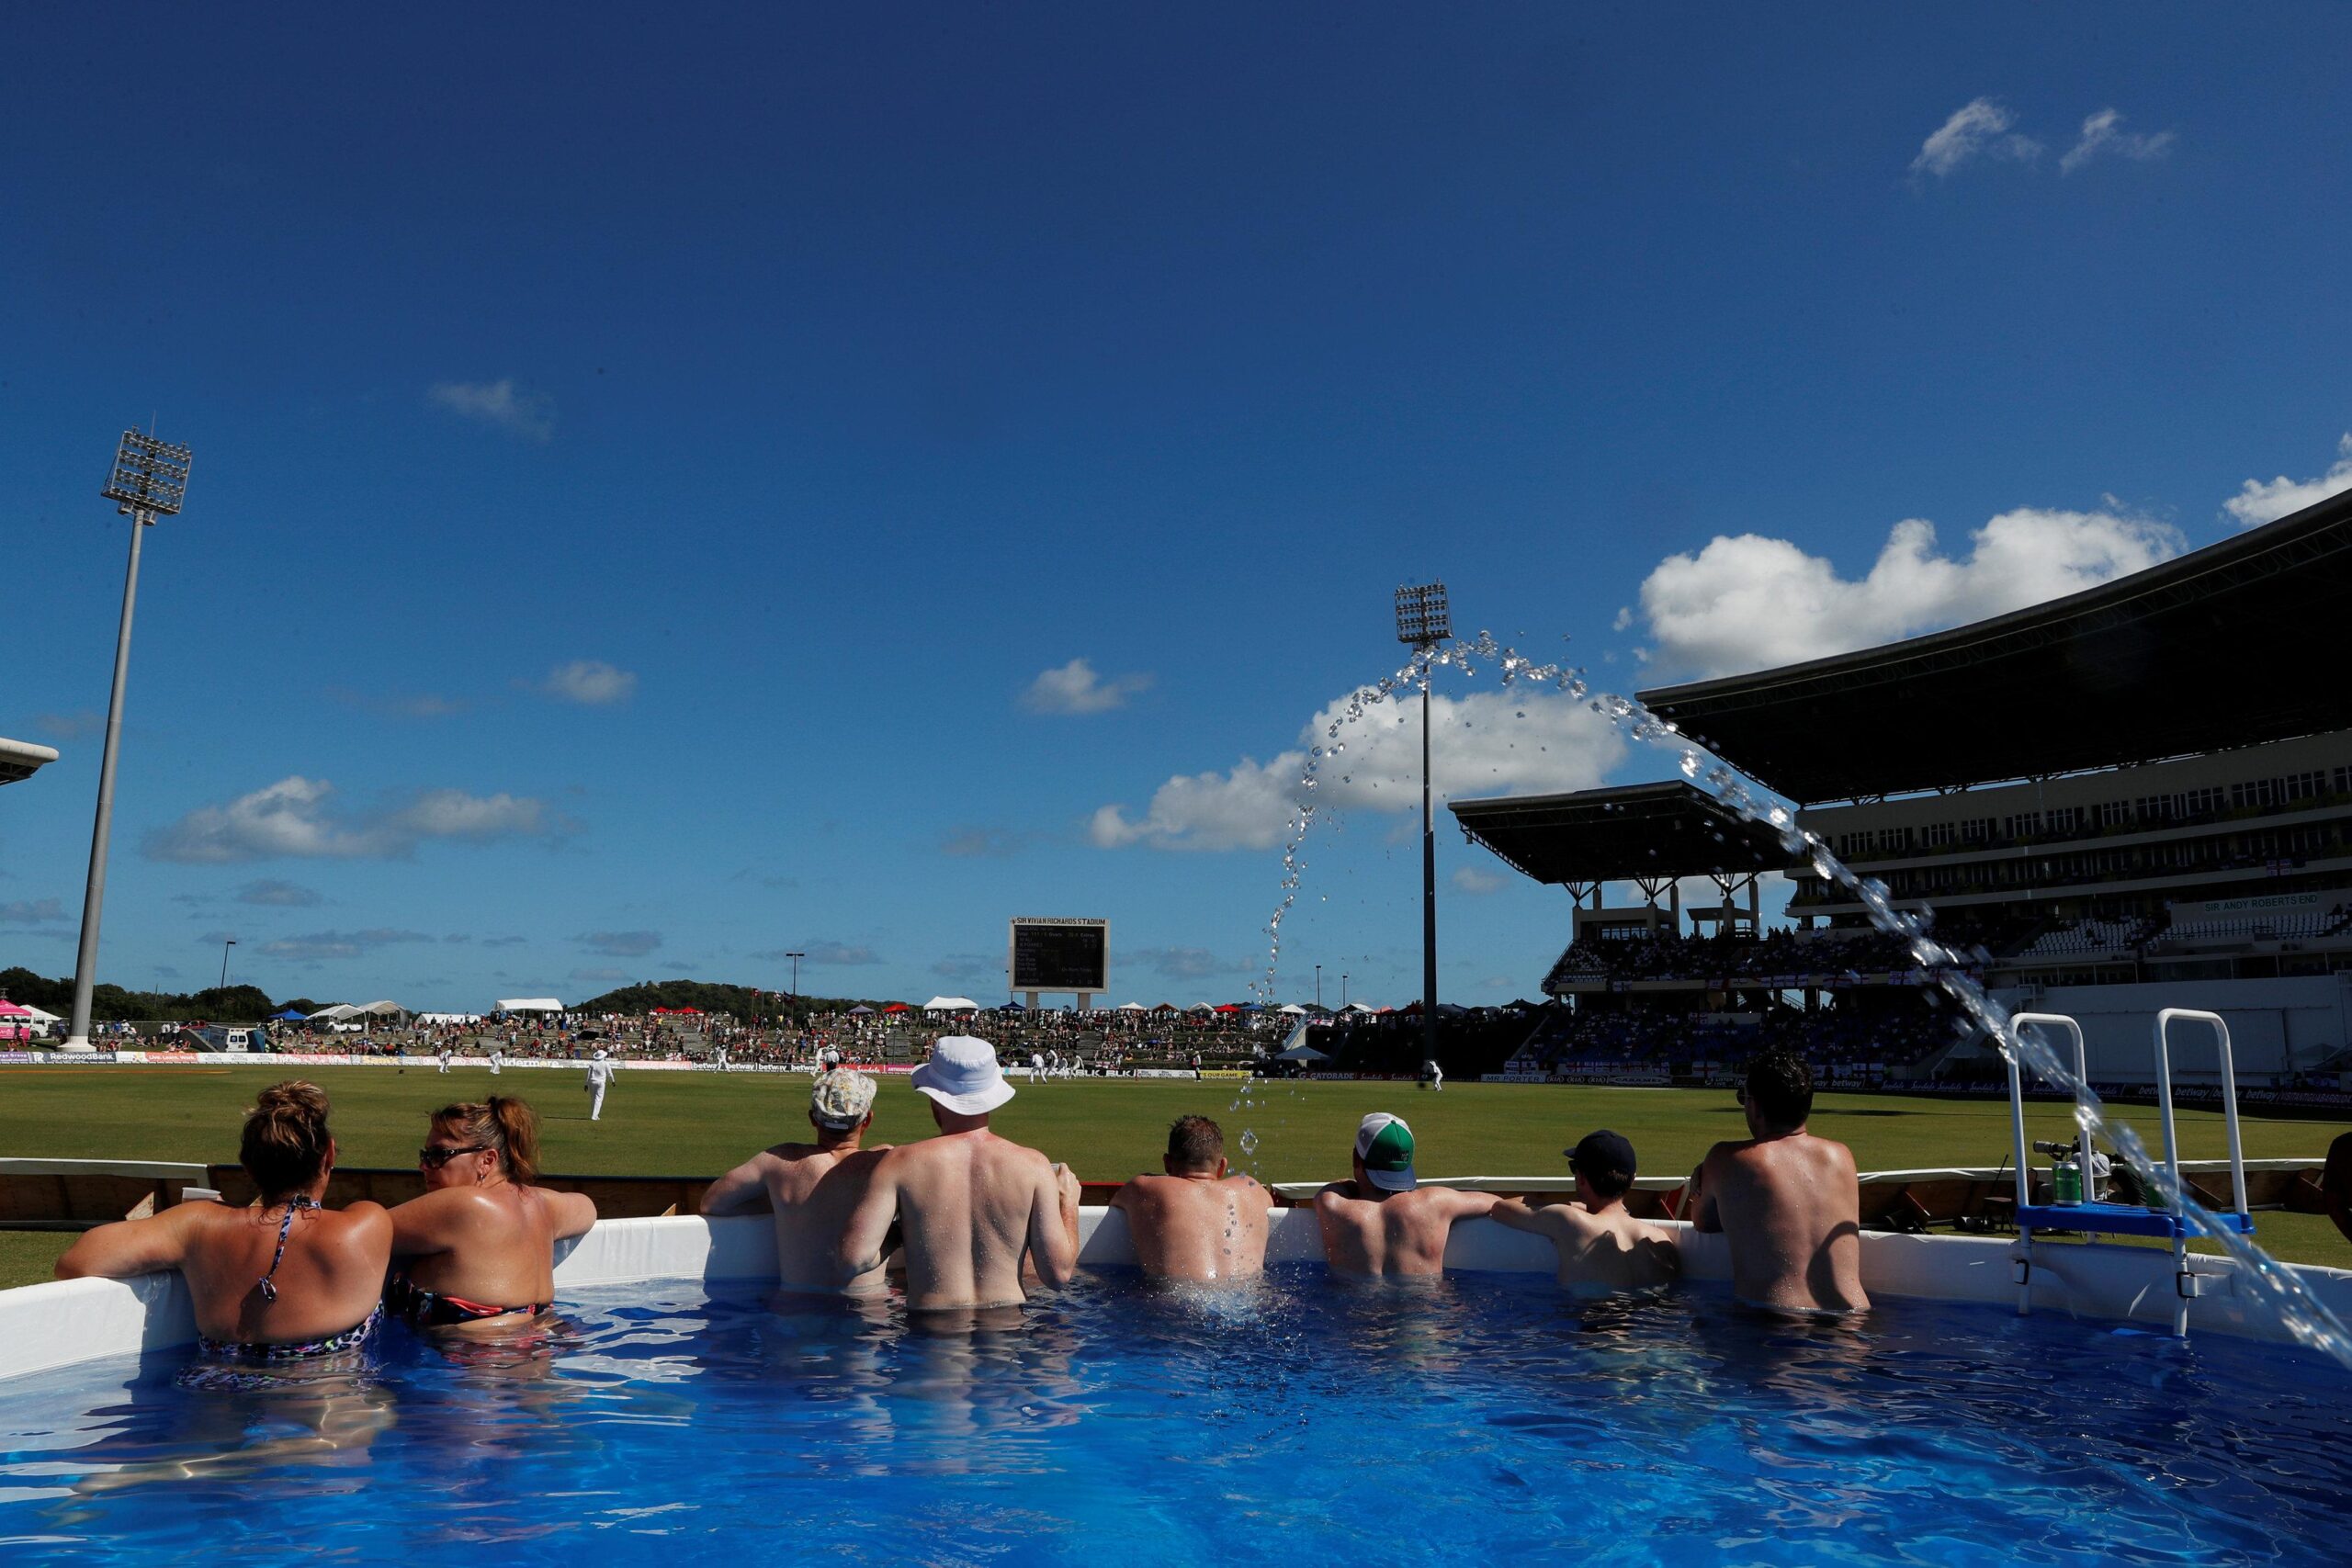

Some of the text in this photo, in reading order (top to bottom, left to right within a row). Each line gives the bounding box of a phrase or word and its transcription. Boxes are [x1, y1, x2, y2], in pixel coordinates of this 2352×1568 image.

[2205, 895, 2317, 912] SIR ANDY ROBERTS END
[1106, 1069, 1131, 1077] BLK
[1310, 1072, 1354, 1080] GATORADE
[1831, 1079, 1861, 1089] betway
[2175, 1087, 2210, 1098] betway
[2246, 1089, 2278, 1101] betway
